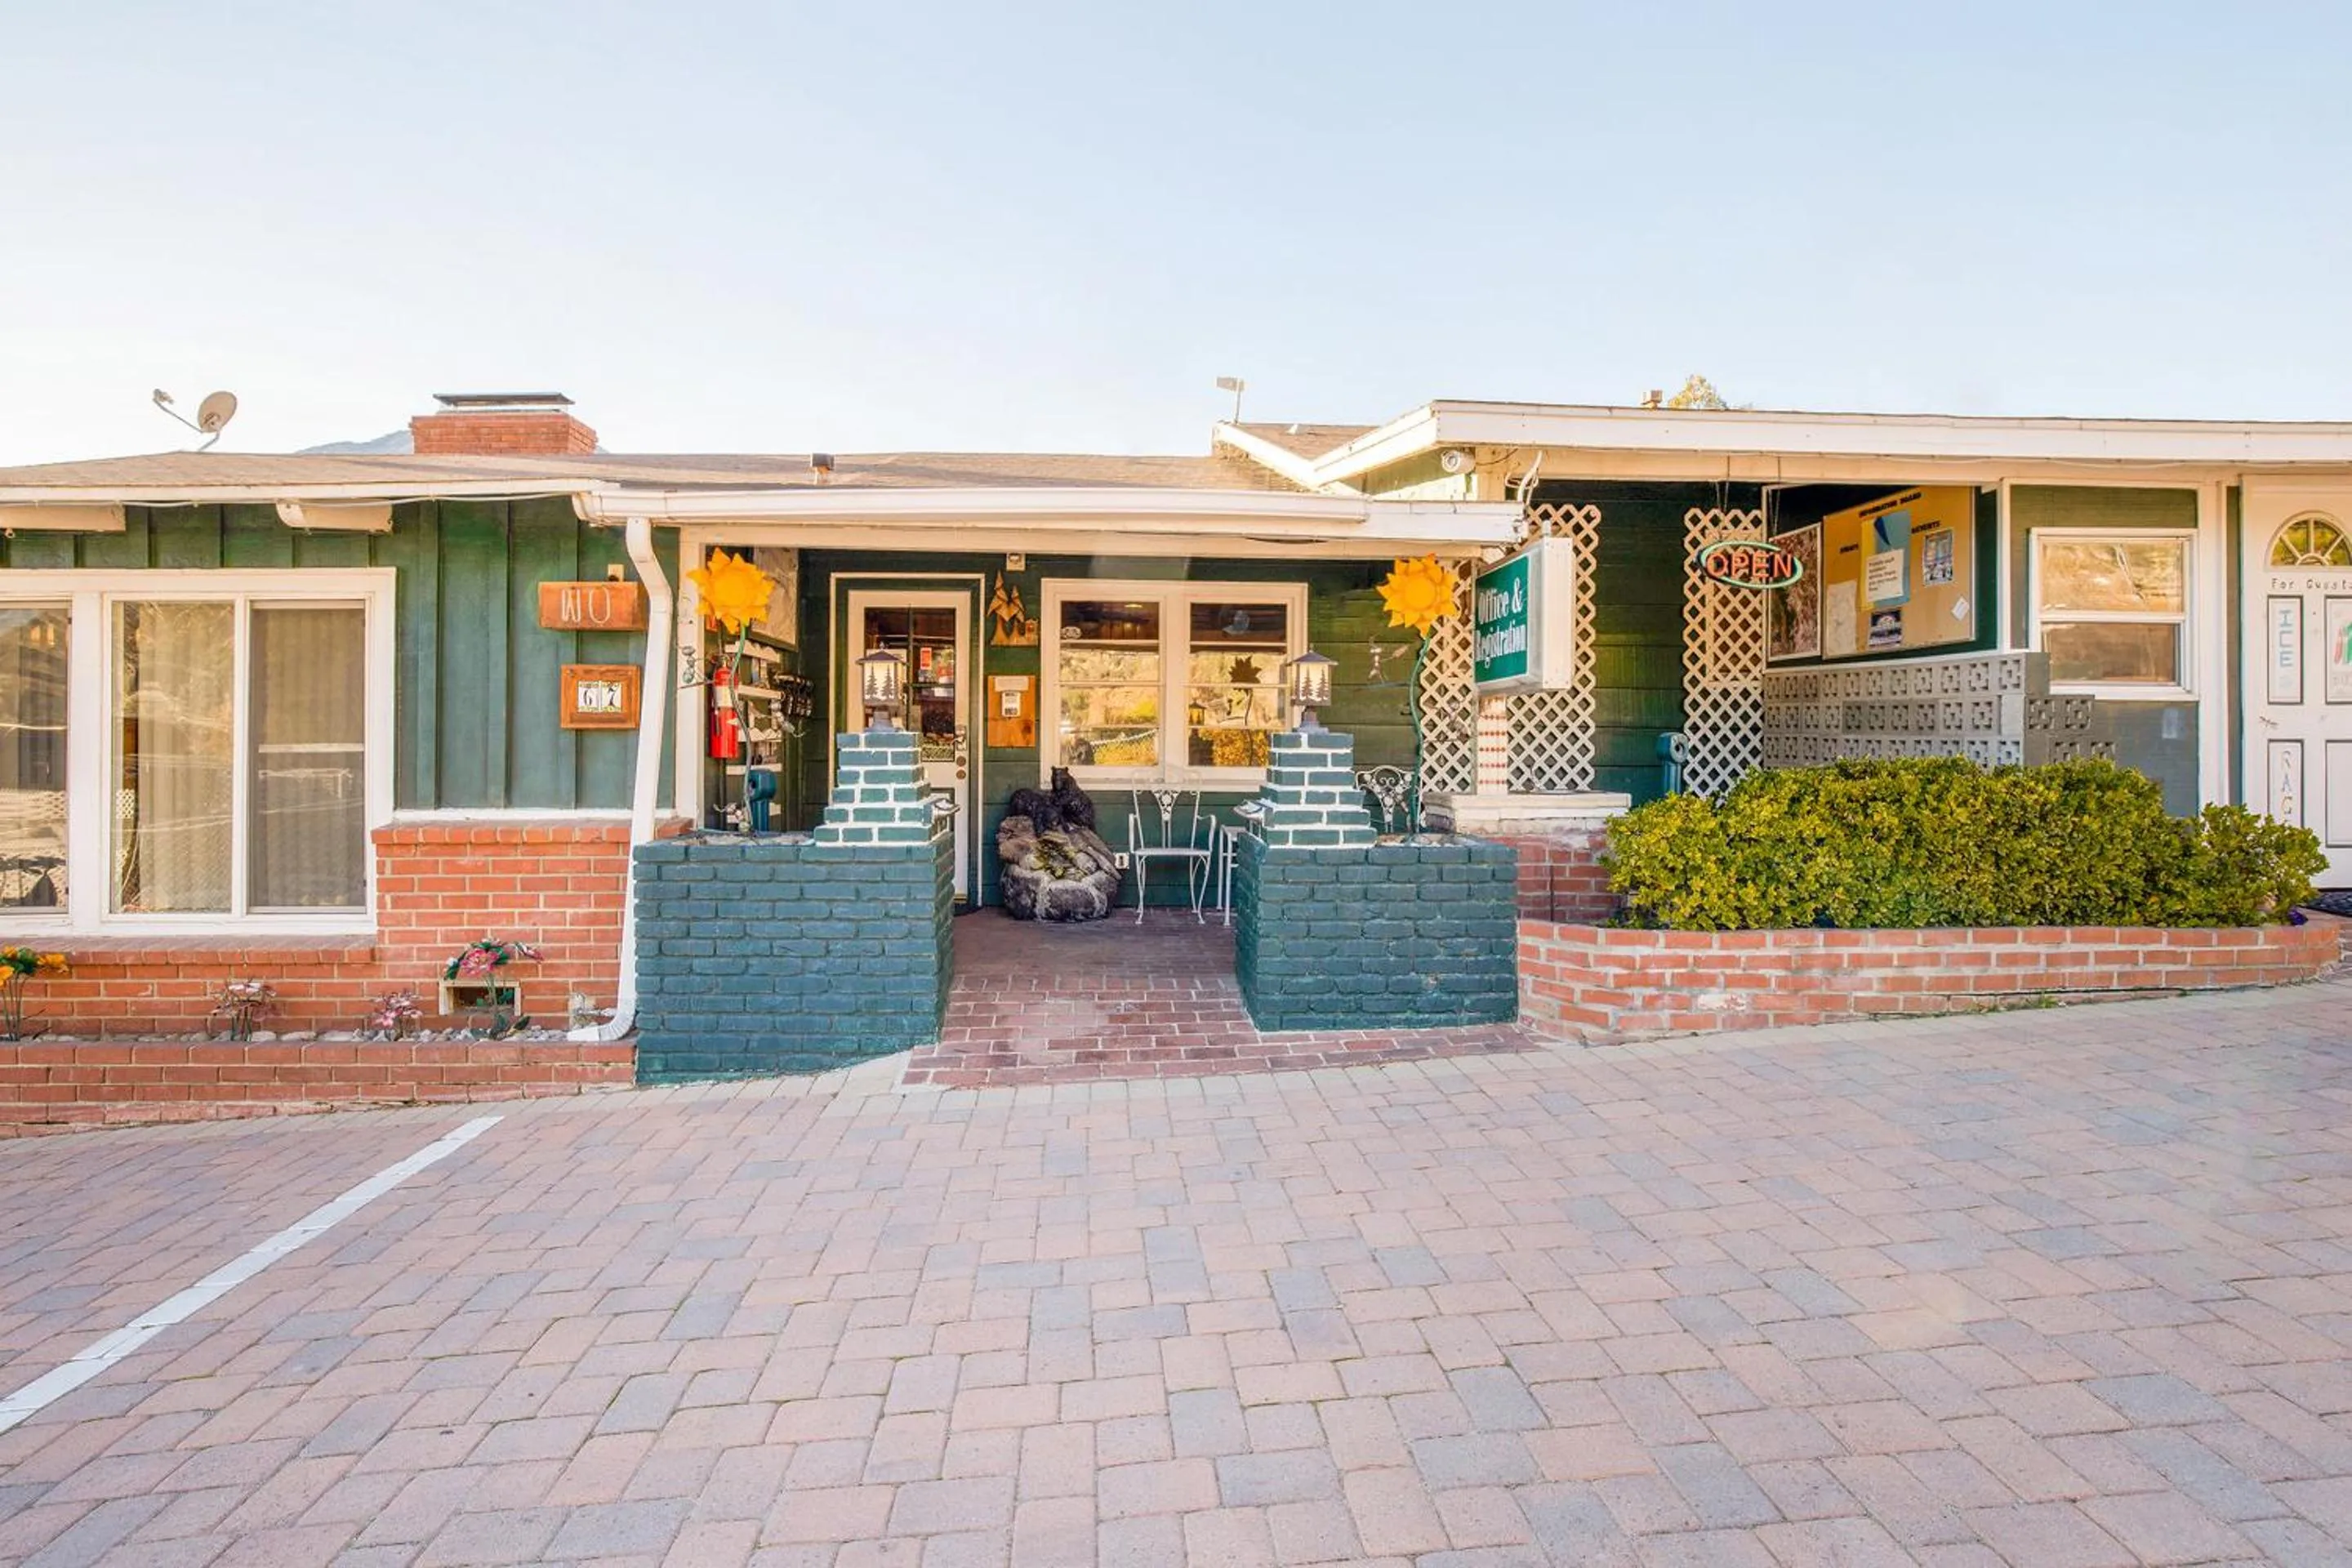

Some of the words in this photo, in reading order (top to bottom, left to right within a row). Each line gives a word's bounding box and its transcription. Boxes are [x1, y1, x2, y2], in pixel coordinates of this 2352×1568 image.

[1707, 550, 1793, 580] OPEN
[2271, 577, 2295, 589] For
[561, 586, 611, 625] NO
[1477, 588, 1509, 625] Office
[1512, 577, 1524, 614] &
[1474, 618, 1526, 669] Registration
[2278, 609, 2293, 667] ICE
[582, 685, 618, 707] 67
